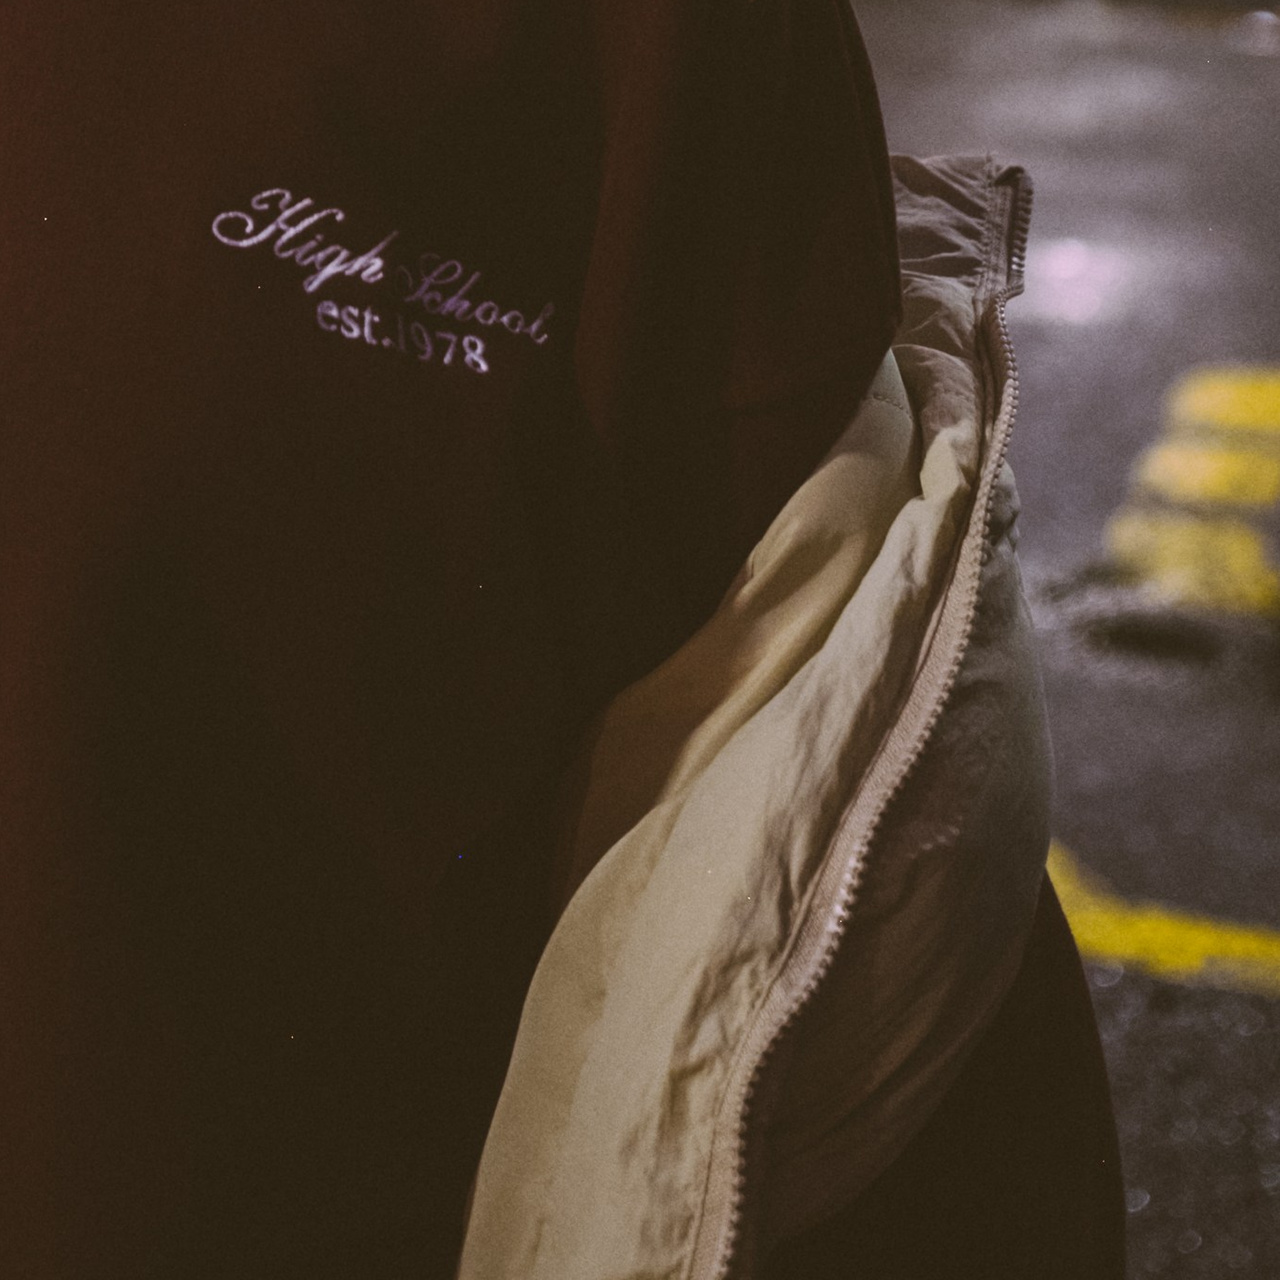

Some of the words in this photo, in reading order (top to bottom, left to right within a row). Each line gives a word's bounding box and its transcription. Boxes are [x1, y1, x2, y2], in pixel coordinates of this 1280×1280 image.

[212, 188, 399, 293] High
[397, 252, 554, 344] School
[317, 300, 393, 349] est.
[397, 315, 490, 374] 1978
